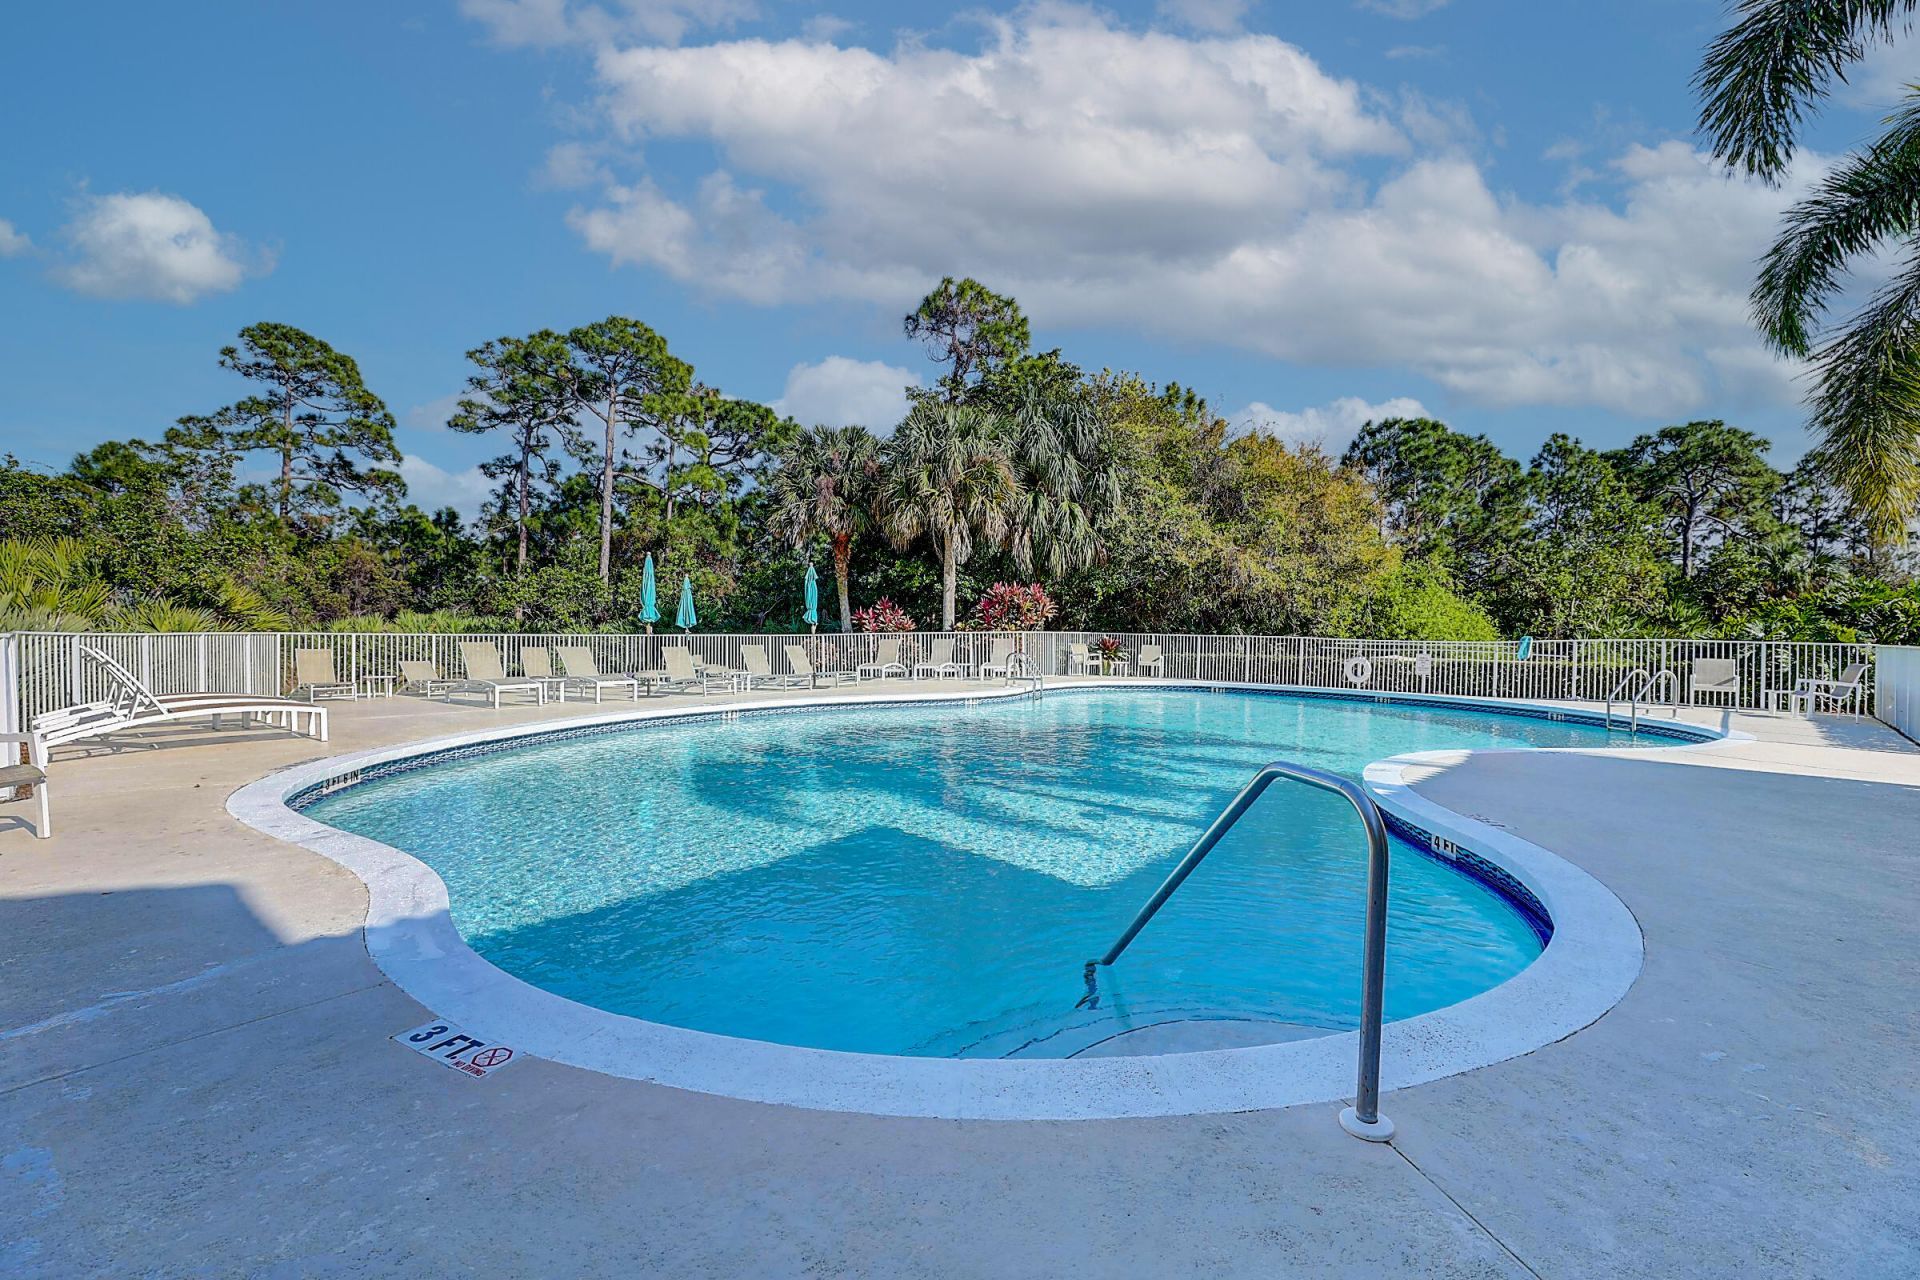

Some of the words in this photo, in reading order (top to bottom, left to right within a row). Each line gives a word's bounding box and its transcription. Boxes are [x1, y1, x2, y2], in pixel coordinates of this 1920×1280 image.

[325, 779, 330, 790] 3
[343, 773, 348, 784] 6
[350, 769, 358, 782] IN
[1434, 835, 1440, 850] 4
[409, 1025, 448, 1042] 3
[428, 1034, 486, 1059] FT.
